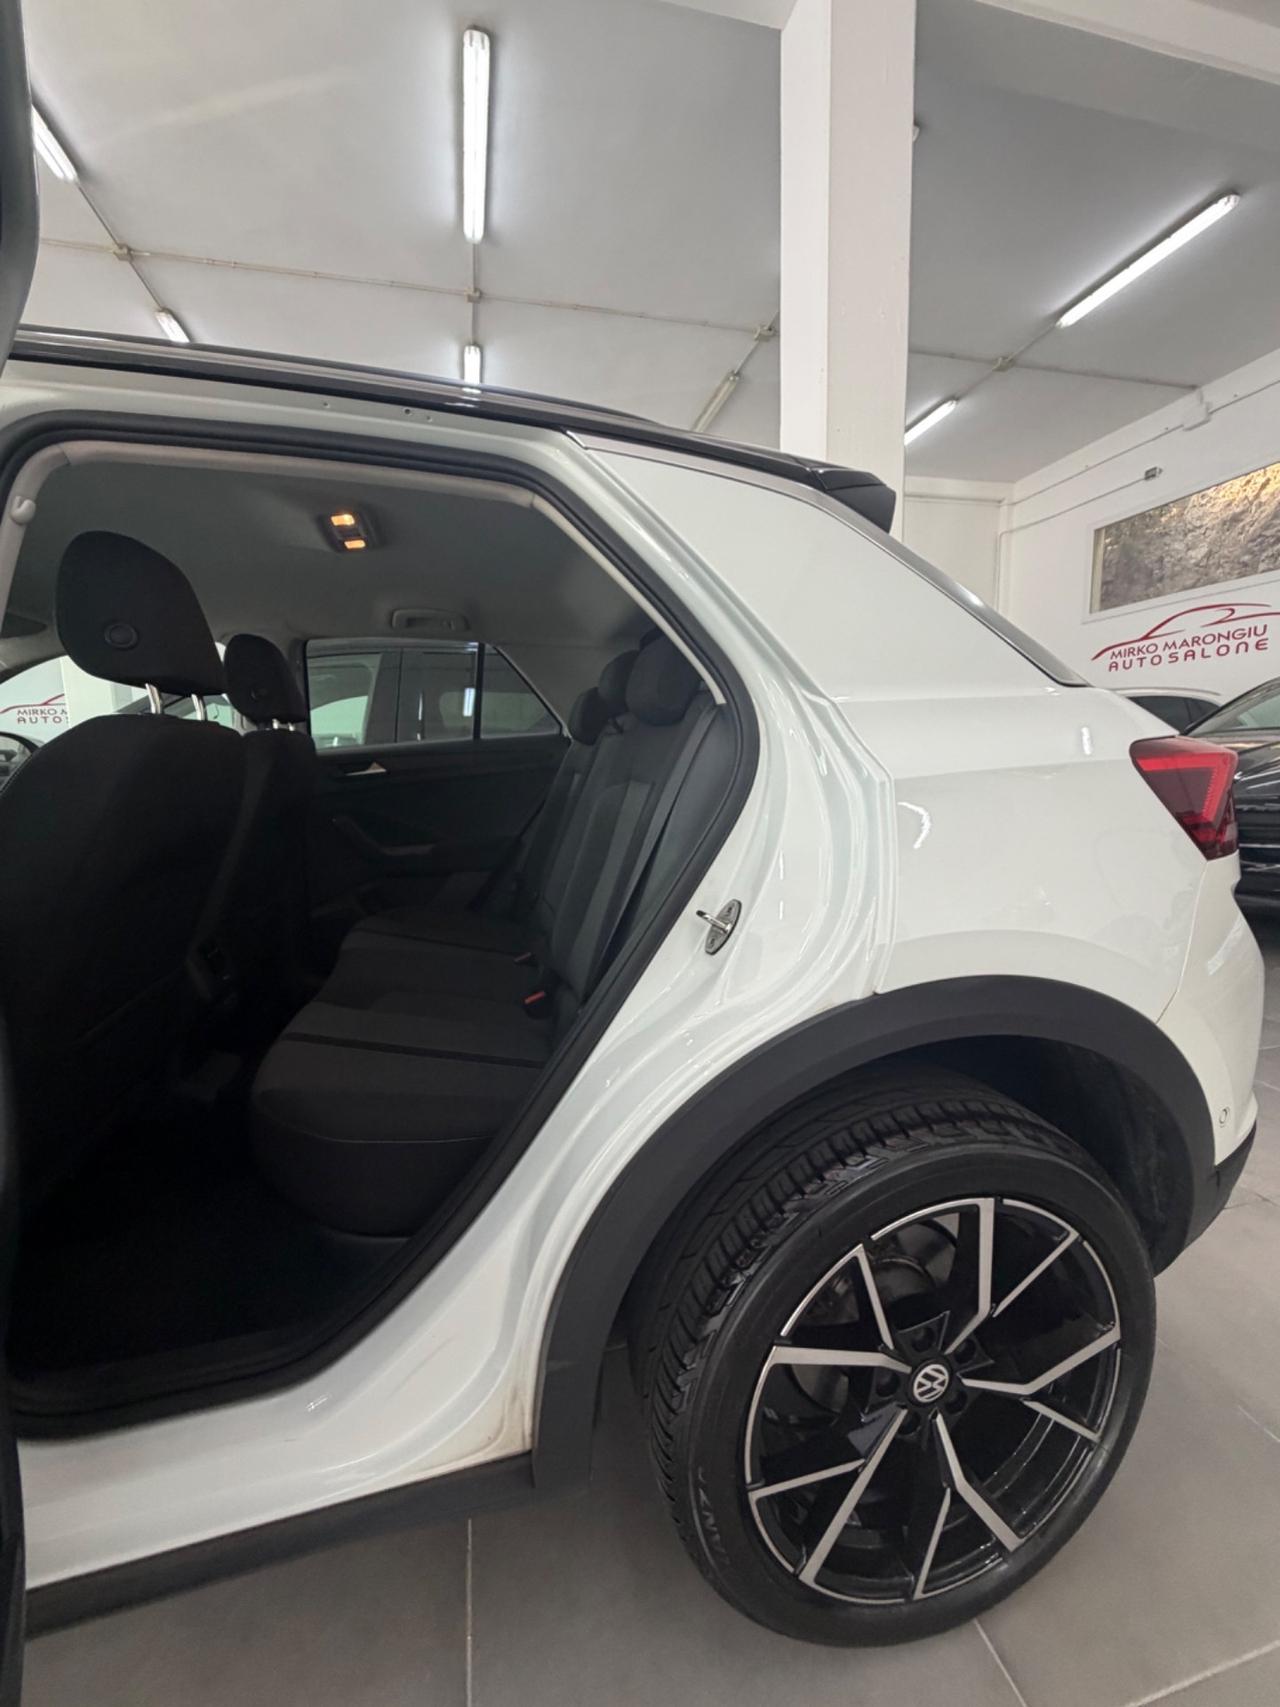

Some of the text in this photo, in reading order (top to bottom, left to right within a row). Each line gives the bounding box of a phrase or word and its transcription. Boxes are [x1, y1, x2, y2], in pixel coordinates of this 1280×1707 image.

[1108, 638, 1269, 673] AUTOSALONE
[1110, 624, 1267, 661] MIRKO MARONGIU
[17, 708, 57, 716] MIRKO
